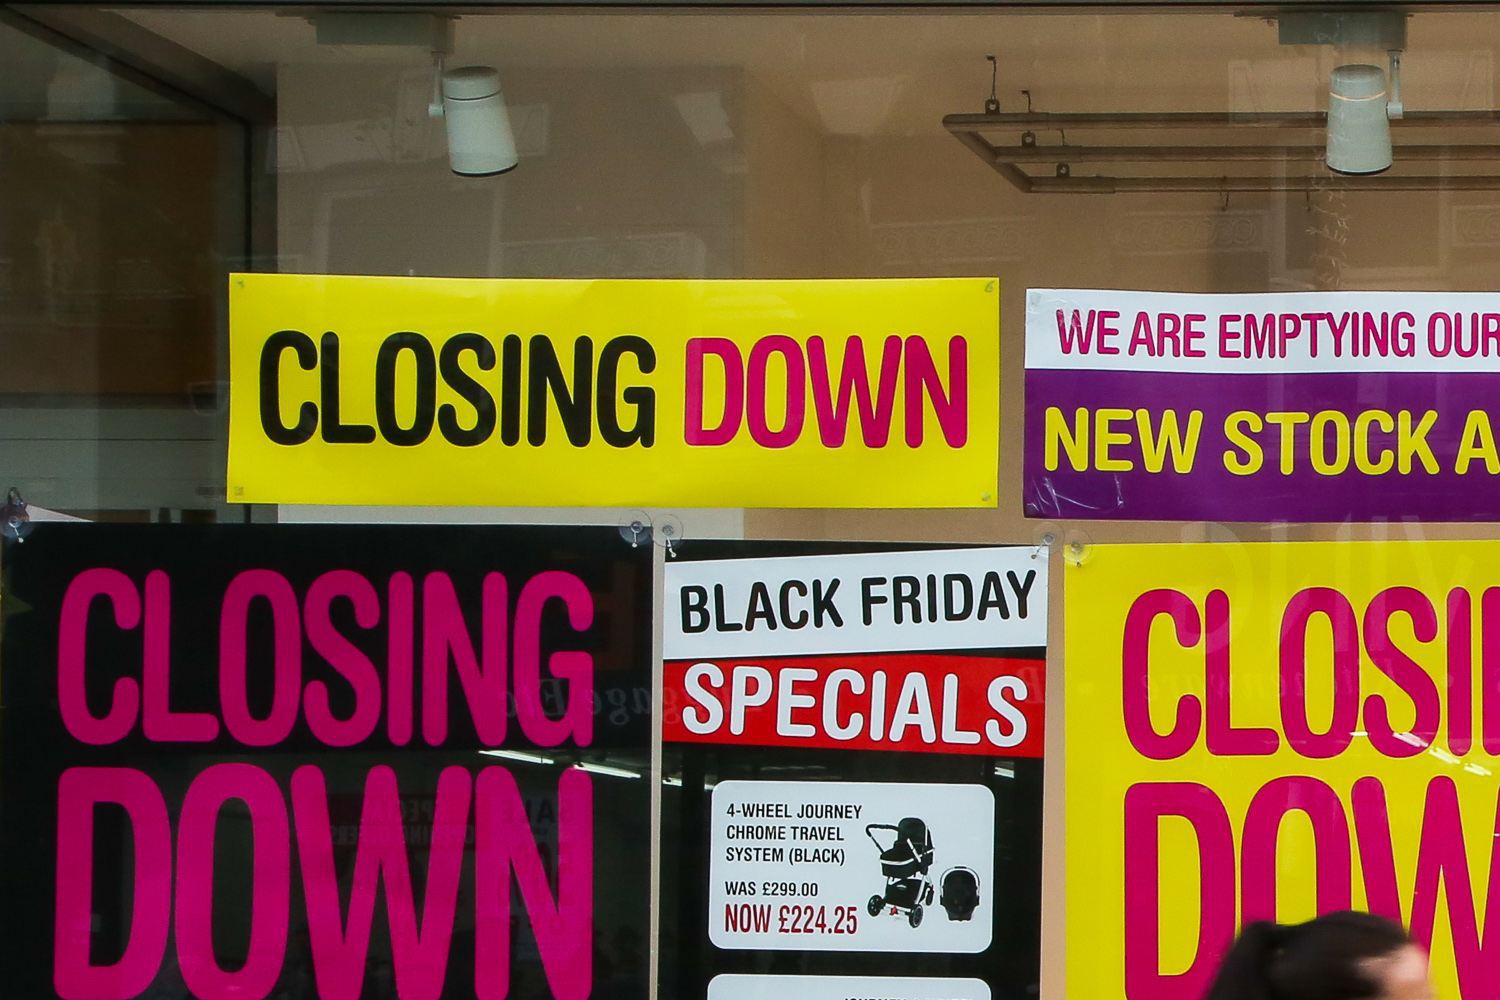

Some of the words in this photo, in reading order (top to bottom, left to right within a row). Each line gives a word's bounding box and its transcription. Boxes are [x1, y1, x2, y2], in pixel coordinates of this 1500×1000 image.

[1056, 309, 1120, 354] WE
[1128, 312, 1206, 357] ARE
[1219, 312, 1415, 359] EMPTYING
[260, 330, 656, 448] CLOSING
[684, 335, 968, 449] DOWN
[1045, 407, 1203, 473] NEW
[1223, 410, 1439, 475] STOCK
[681, 578, 843, 633] BLACK
[861, 570, 1036, 626] FRIDAY
[58, 568, 595, 747] CLOSING
[683, 663, 1027, 747] SPECIALS
[727, 803, 792, 817] 4-WHEEL
[797, 804, 862, 819] JOURNEY
[727, 825, 786, 840] CHROME
[790, 826, 844, 841] TRAVEL
[726, 847, 783, 862] SYSTEM
[789, 848, 844, 866] (BLACK)
[725, 881, 756, 895] WAS
[763, 882, 818, 896] £299.00
[726, 904, 771, 932] NOW
[779, 905, 857, 934] £224.25
